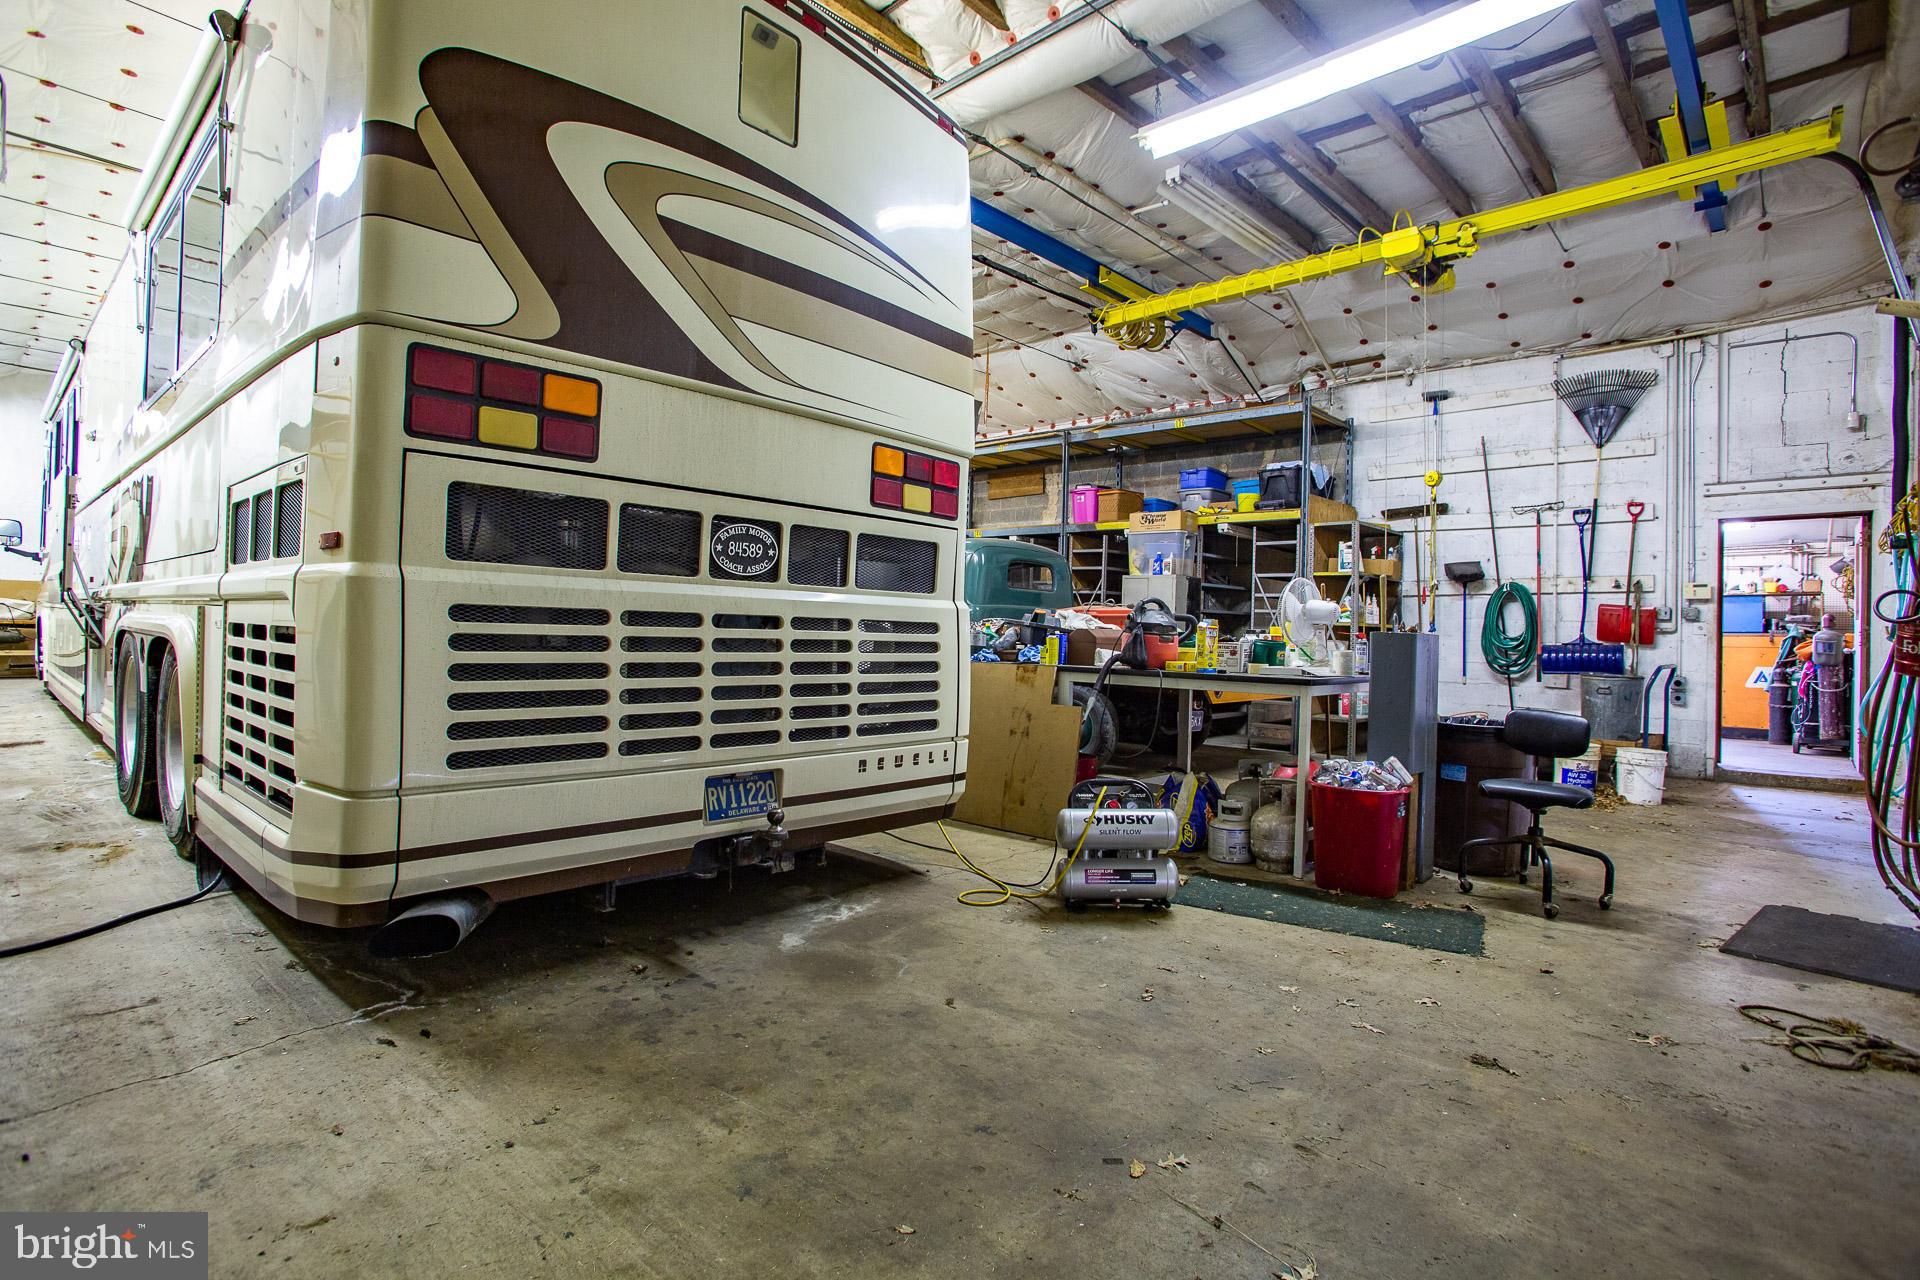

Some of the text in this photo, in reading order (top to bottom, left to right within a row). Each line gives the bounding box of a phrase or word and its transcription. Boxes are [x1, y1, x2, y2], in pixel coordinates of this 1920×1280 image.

[720, 527, 773, 546] FAMILY MOTOR
[728, 541, 763, 558] 84589
[720, 556, 744, 573] COACH
[707, 780, 776, 812] RV11220
[728, 806, 761, 816] DELAWARE
[1103, 814, 1155, 825] HUSKY
[1099, 828, 1142, 836] SILENT FLOW
